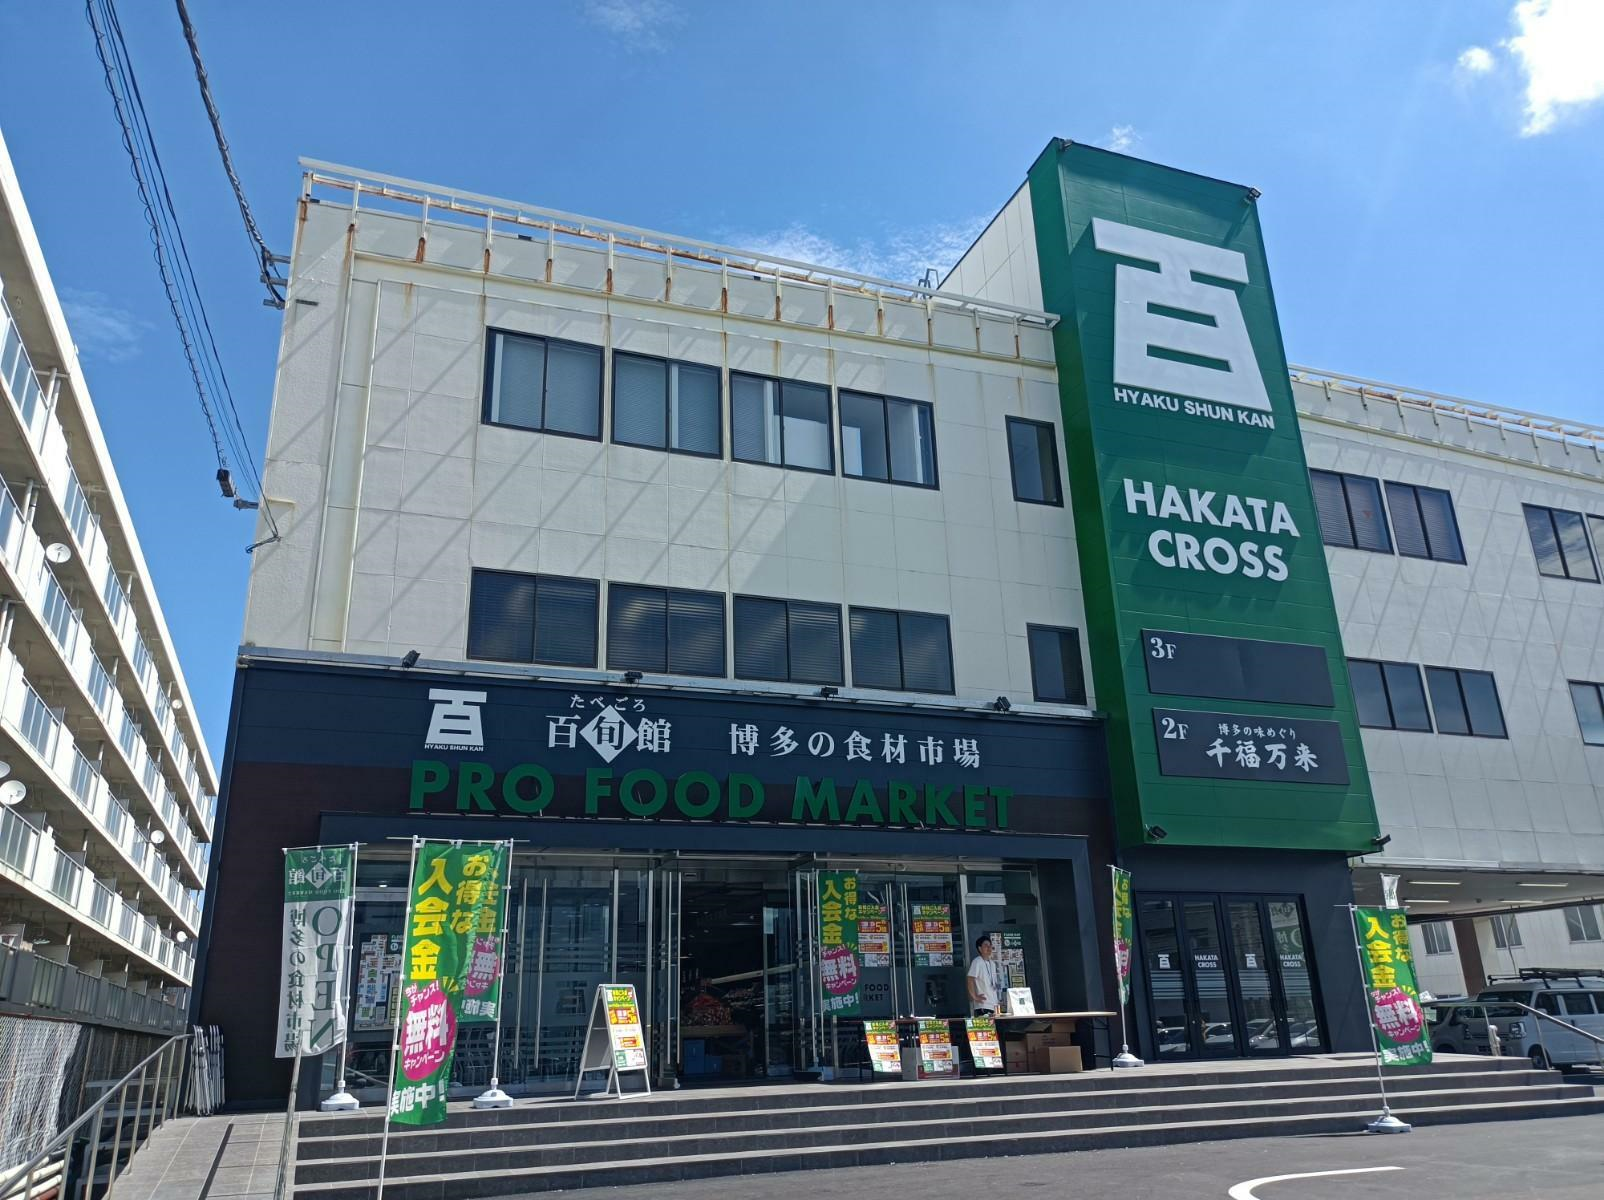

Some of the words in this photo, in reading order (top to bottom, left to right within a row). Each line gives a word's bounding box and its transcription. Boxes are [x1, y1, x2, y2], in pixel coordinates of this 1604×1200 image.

[1114, 387, 1179, 412] HYAKU
[1184, 400, 1233, 423] SHUN
[1237, 410, 1275, 430] KAN
[1123, 478, 1300, 538] HAKATA
[1148, 529, 1288, 582] CROSS
[1150, 637, 1177, 660] 3F
[569, 693, 647, 713] たべごろ
[545, 712, 672, 755] 百旬館
[728, 723, 981, 769] 博多の食材市場
[1161, 717, 1189, 740] 2F
[1218, 723, 1296, 741] 博多の味めぐり
[1206, 738, 1319, 773] 千福万来
[409, 760, 555, 814] PRO
[584, 766, 765, 818] FOOD
[791, 776, 1016, 828] MARKET
[450, 853, 489, 934] お得な
[822, 879, 843, 944] 入会金
[843, 877, 857, 921] お得な
[410, 858, 453, 980] 入会金
[1391, 914, 1412, 963] お得な
[821, 953, 857, 982] 無料
[1195, 954, 1219, 962] HAKATA
[1366, 916, 1397, 988] 入会金
[404, 999, 449, 1057] 無料
[1374, 998, 1419, 1031] 無料
[403, 1049, 445, 1071] キャンペーン
